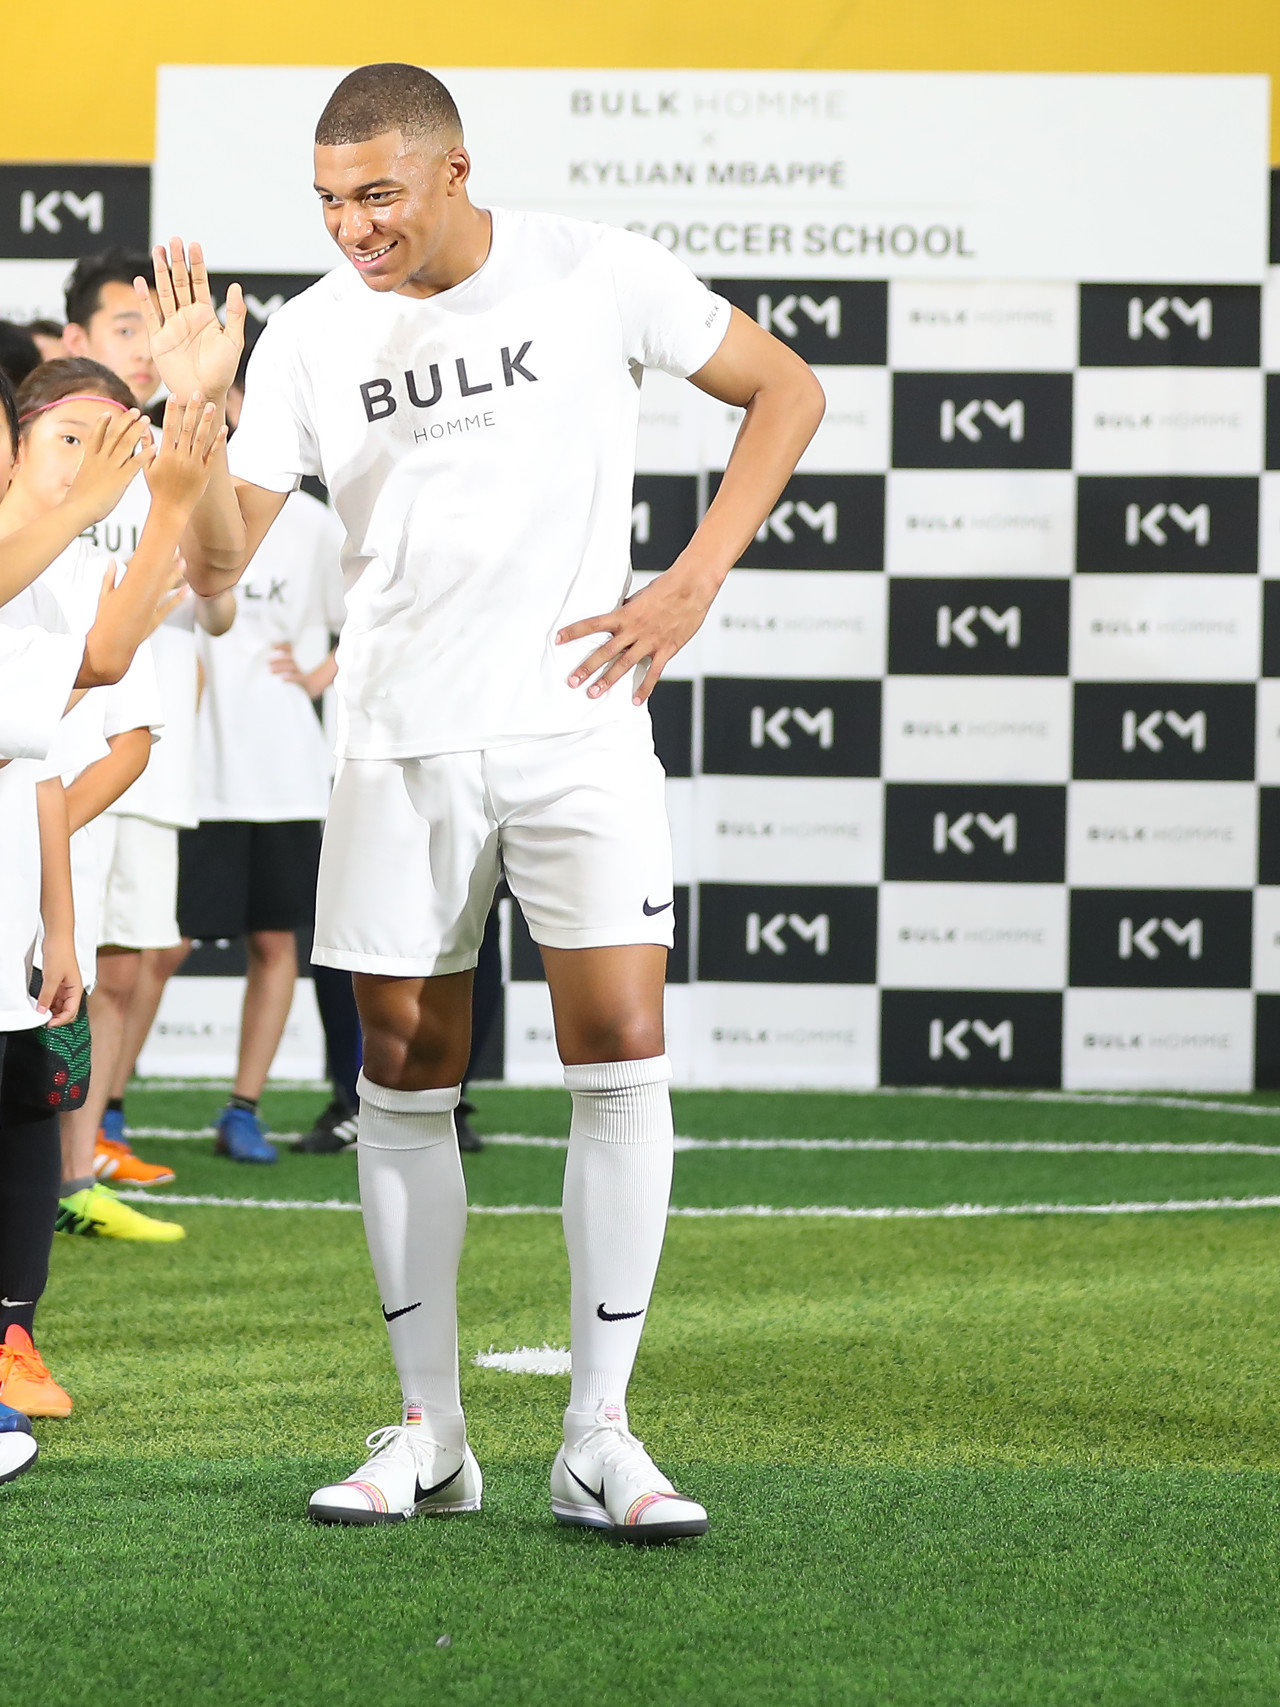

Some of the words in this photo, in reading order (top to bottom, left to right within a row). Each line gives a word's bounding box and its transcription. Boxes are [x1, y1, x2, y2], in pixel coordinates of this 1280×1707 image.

[569, 89, 680, 117] BULK
[692, 90, 847, 119] HOMME
[569, 162, 696, 186] KYLIAN
[706, 160, 846, 188] MBAPPÉ
[20, 191, 104, 233] KM
[625, 222, 793, 255] OCCER
[803, 224, 975, 258] SCHOOL
[704, 305, 719, 328] BULK
[757, 294, 841, 339] KM
[1128, 297, 1212, 339] KM
[359, 340, 539, 423] BULK
[413, 411, 496, 444] HOMME
[940, 399, 1024, 442] KM
[1125, 503, 1210, 545] KM
[937, 605, 1021, 647] KM
[750, 706, 833, 748] KM
[1122, 710, 1206, 752] KM
[933, 812, 1017, 854] KM
[746, 913, 829, 954] KM
[1118, 918, 1203, 959] KM
[929, 1019, 1013, 1060] KM
